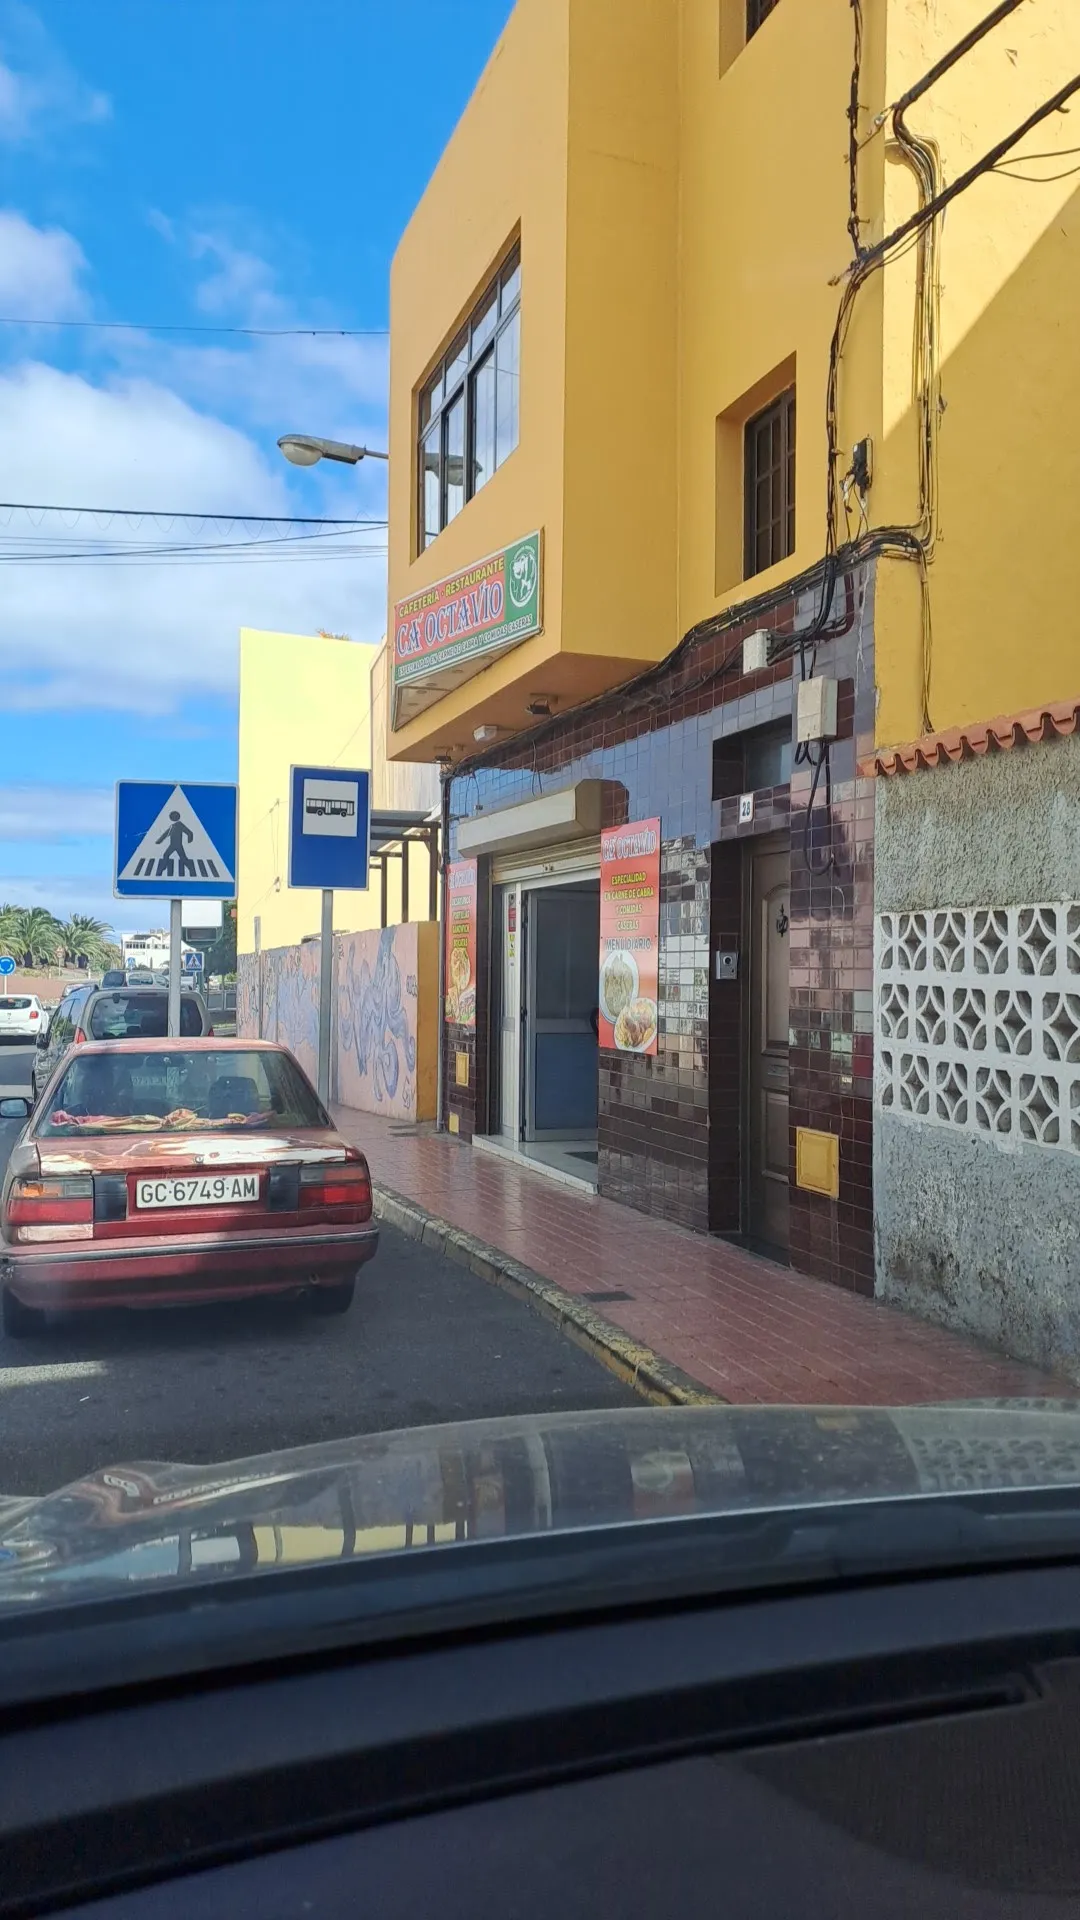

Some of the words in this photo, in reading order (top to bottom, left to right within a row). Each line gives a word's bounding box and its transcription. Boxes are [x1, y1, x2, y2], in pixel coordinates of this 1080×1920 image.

[445, 556, 505, 596] RESTAURANTE
[398, 655, 431, 677] ESPECIALIDAD
[437, 647, 454, 662] CARNE
[462, 638, 479, 653] CABRA
[483, 626, 508, 644] COMIDAS
[507, 614, 533, 634] CASERAS
[742, 801, 751, 816] 28
[611, 871, 647, 885] ESPECIALIDAD
[611, 889, 629, 901] CARNE
[629, 888, 636, 900] DE
[636, 886, 654, 899] CABRA
[619, 903, 642, 915] COMIDAS
[616, 920, 639, 932] CASERAS
[625, 937, 652, 951] DIARIO
